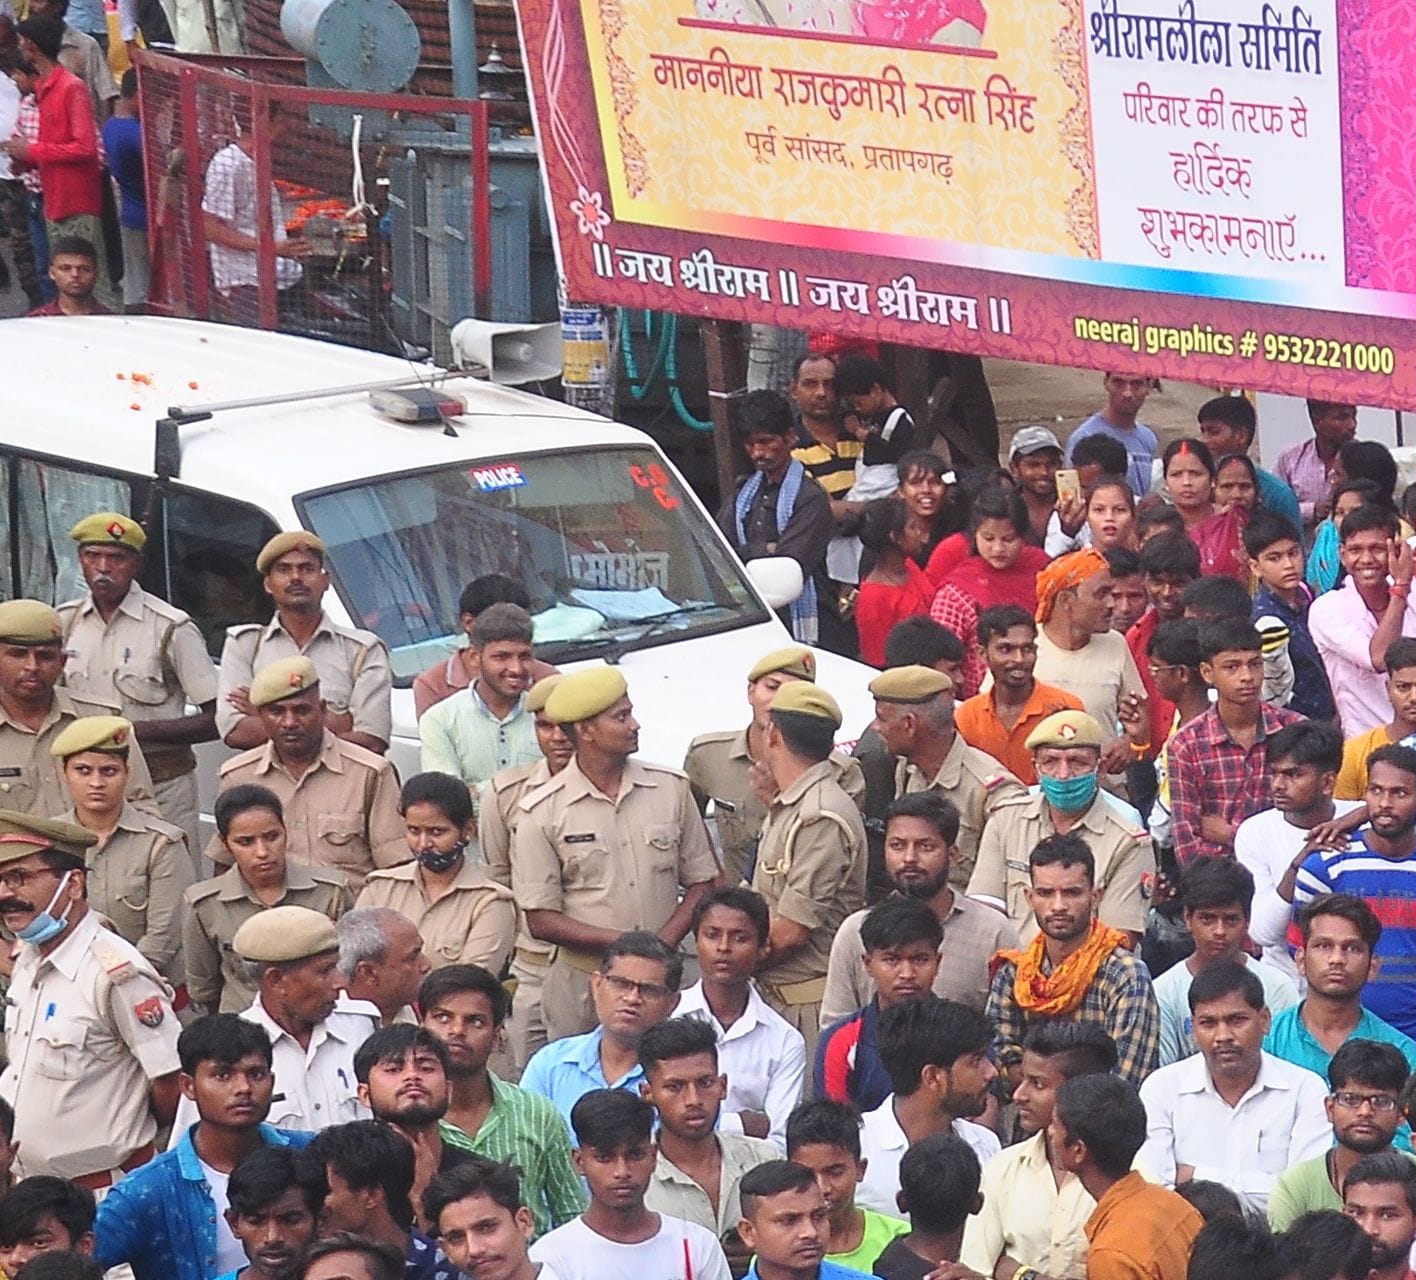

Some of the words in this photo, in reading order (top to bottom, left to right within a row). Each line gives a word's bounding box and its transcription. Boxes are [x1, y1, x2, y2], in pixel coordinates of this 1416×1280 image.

[1238, 3, 1322, 75] समिति
[649, 46, 762, 99] माननीया
[771, 64, 907, 121] राजकुमारी
[915, 82, 976, 123] रत्ना
[984, 74, 1037, 134] सिंह
[1123, 82, 1191, 128] परिवार
[1196, 88, 1224, 131] की
[1230, 101, 1283, 135] तरफ
[1289, 96, 1309, 138] से
[745, 125, 777, 165] पूर्व
[862, 144, 954, 185] प्रतापगढ़
[1169, 141, 1253, 199] हार्दिक
[616, 248, 672, 287] जय
[679, 248, 770, 301] श्रीराम
[805, 275, 869, 315] जय
[876, 274, 978, 330] श्रीराम
[1074, 315, 1140, 352] neeraj
[1145, 323, 1235, 358] graphics
[1263, 333, 1395, 375] 9532221000
[472, 466, 523, 489] POLICE
